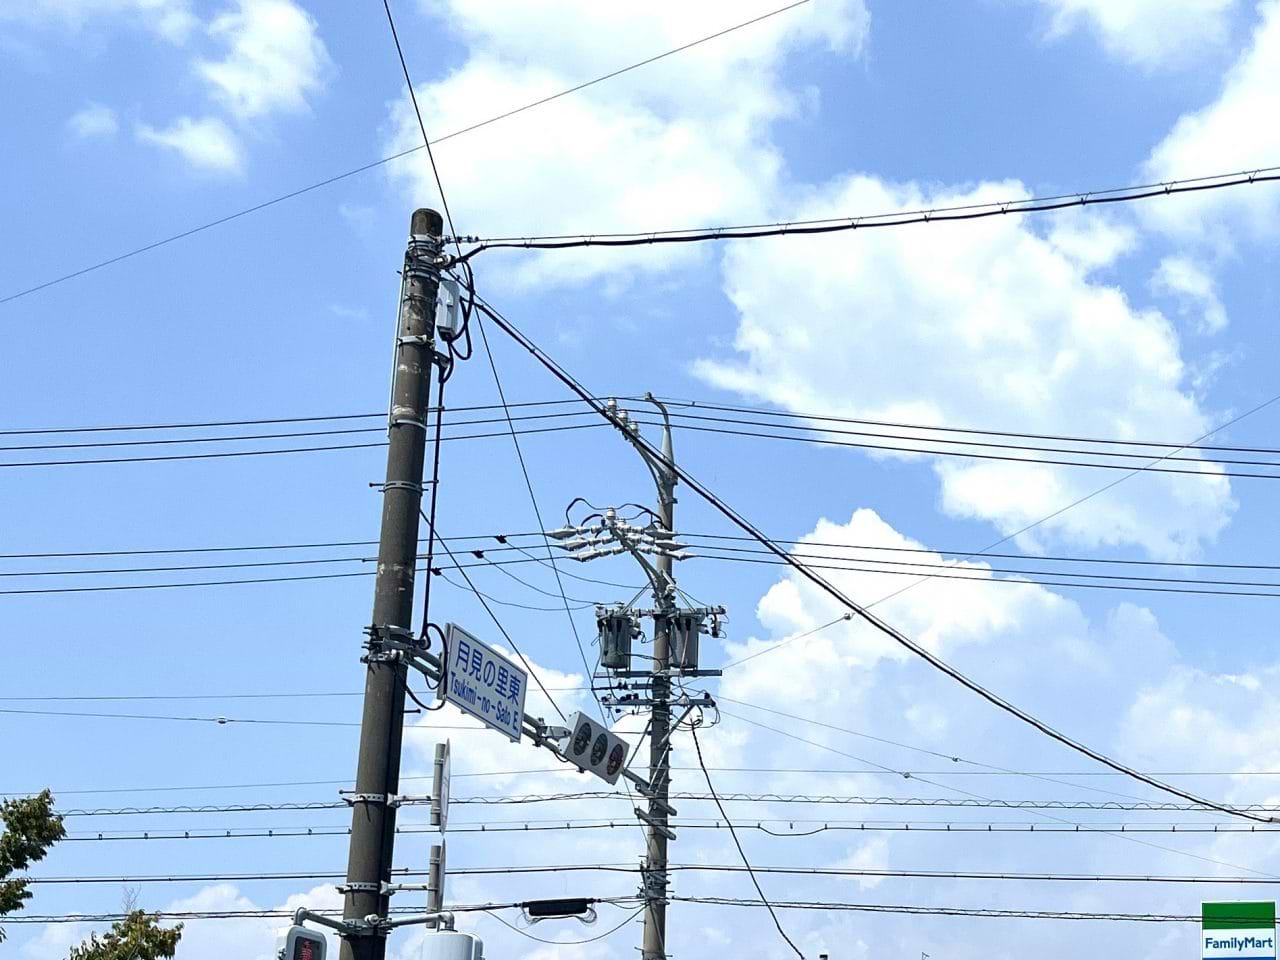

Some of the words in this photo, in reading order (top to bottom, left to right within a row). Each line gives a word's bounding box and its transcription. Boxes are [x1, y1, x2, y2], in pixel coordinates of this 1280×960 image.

[456, 640, 521, 706] 月見の里東
[1205, 937, 1273, 951] FamilyMart
